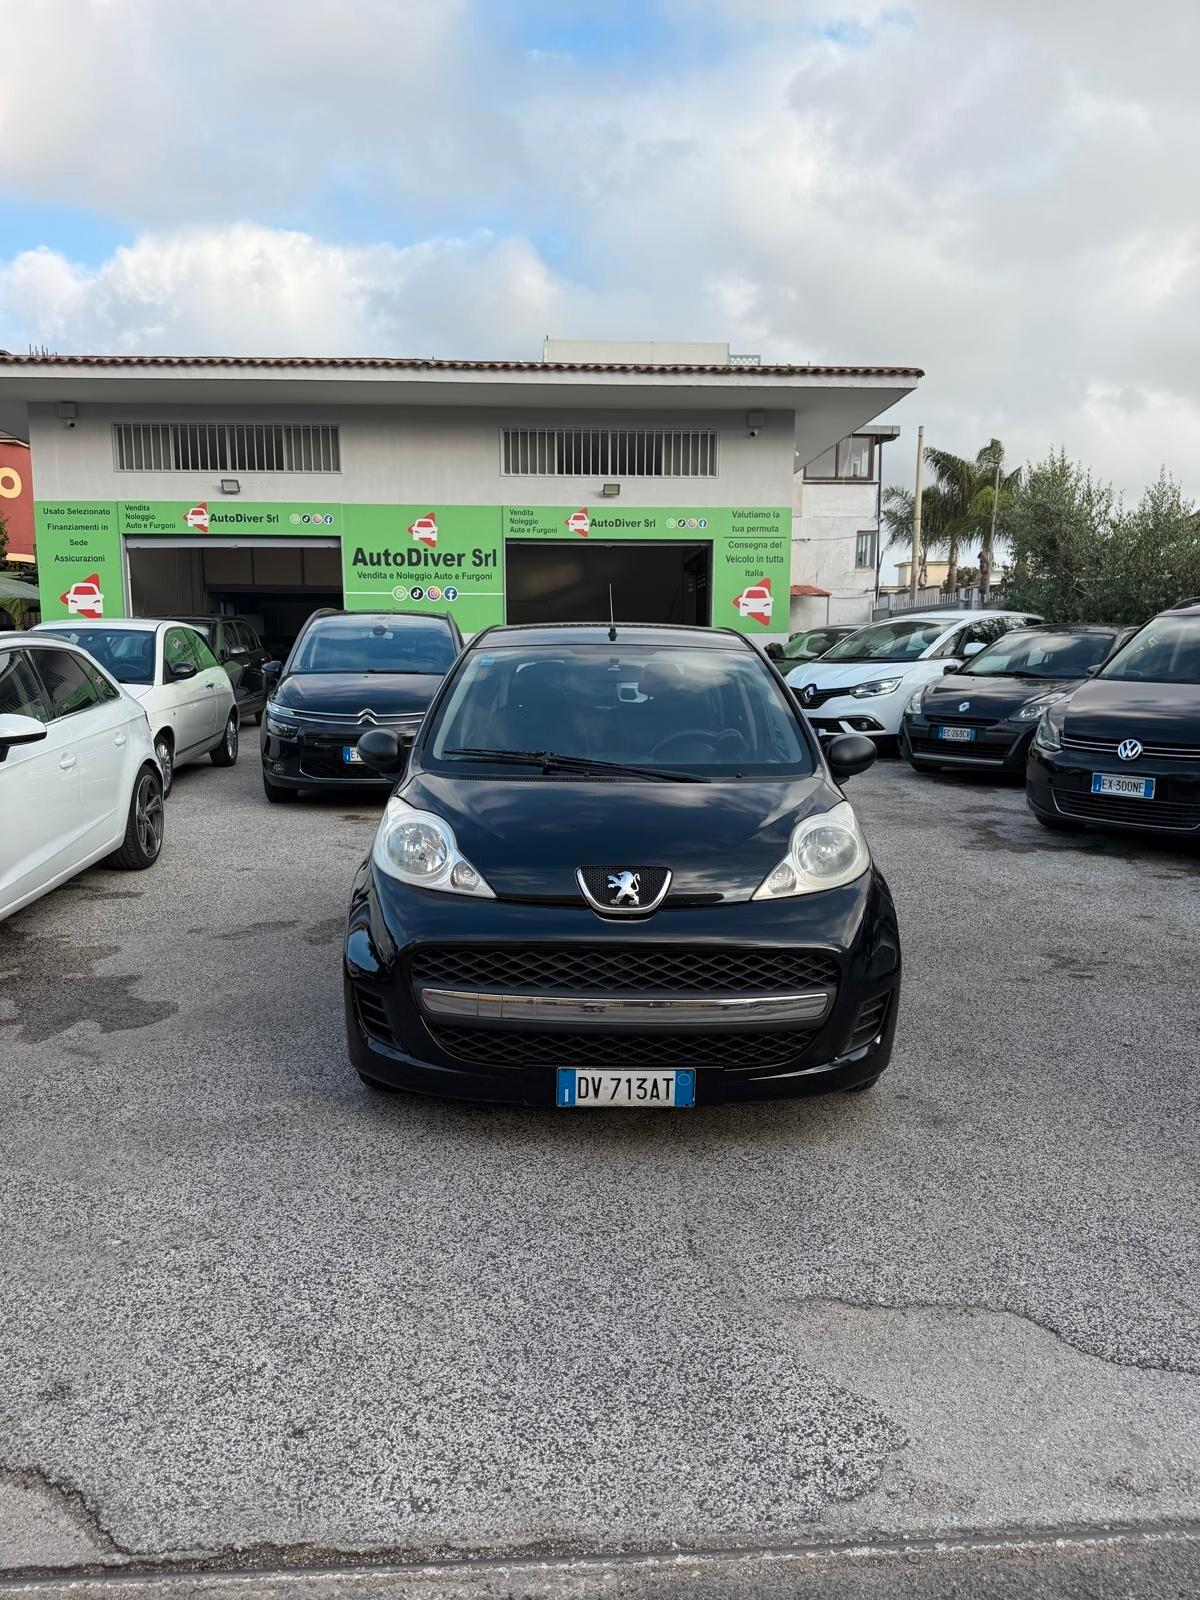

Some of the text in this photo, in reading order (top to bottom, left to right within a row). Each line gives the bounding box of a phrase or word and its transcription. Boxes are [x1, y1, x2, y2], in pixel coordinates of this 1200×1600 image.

[210, 514, 279, 523] AutoDiver Srl
[509, 518, 539, 526] Noleggio
[591, 519, 656, 528] AutoDiver Srl
[532, 527, 558, 535] Furgoni
[747, 526, 779, 534] permuta
[728, 541, 782, 550] Consegna del
[352, 547, 497, 567] AutoDiver Srl
[725, 554, 784, 563] Veicolo in tutta
[357, 572, 387, 580] Vendita
[396, 572, 433, 581] Noleggio
[462, 572, 493, 582] Furgoni
[1102, 779, 1113, 790] EX
[1115, 781, 1144, 793] 300NE
[577, 1076, 602, 1100] DV
[610, 1077, 674, 1100] 713AT
